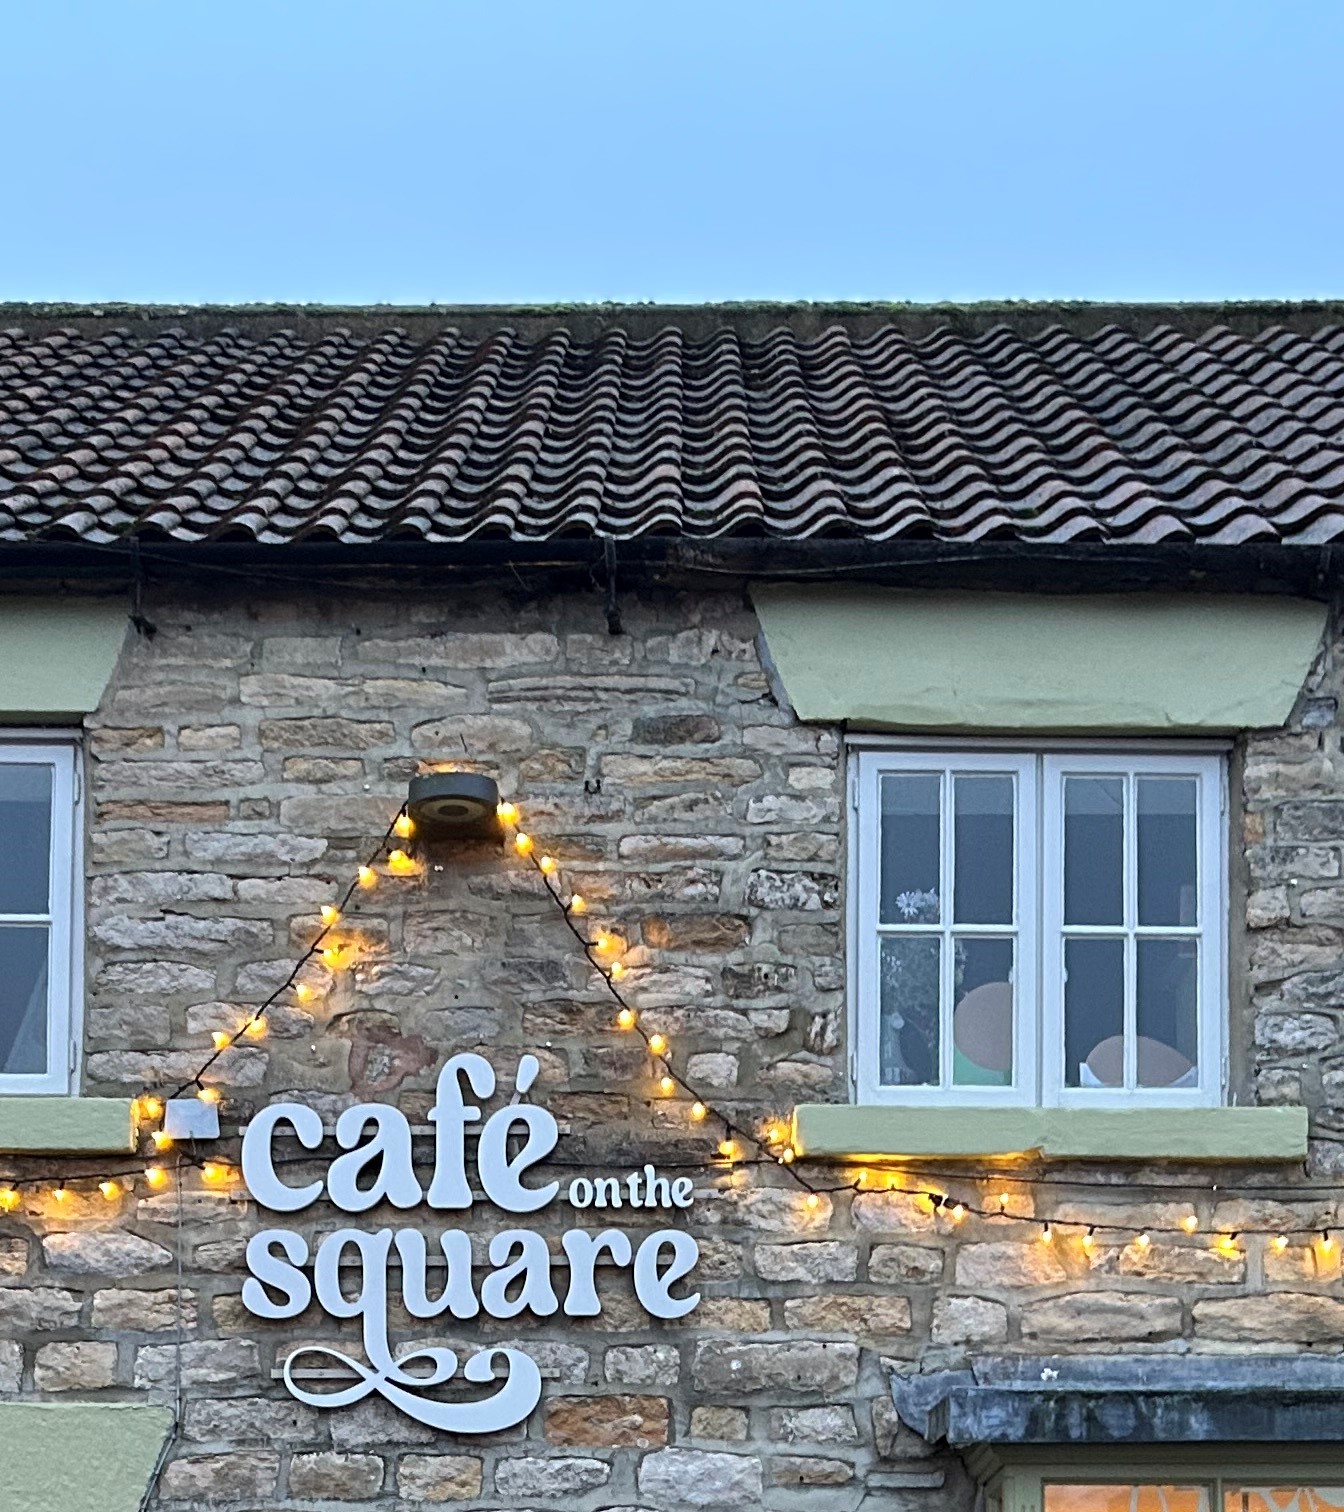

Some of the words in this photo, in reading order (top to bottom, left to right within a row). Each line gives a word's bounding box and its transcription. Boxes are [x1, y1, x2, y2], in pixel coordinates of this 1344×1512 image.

[242, 1052, 560, 1213] café
[569, 1176, 622, 1209] on
[628, 1164, 694, 1209] the
[240, 1227, 702, 1433] square
